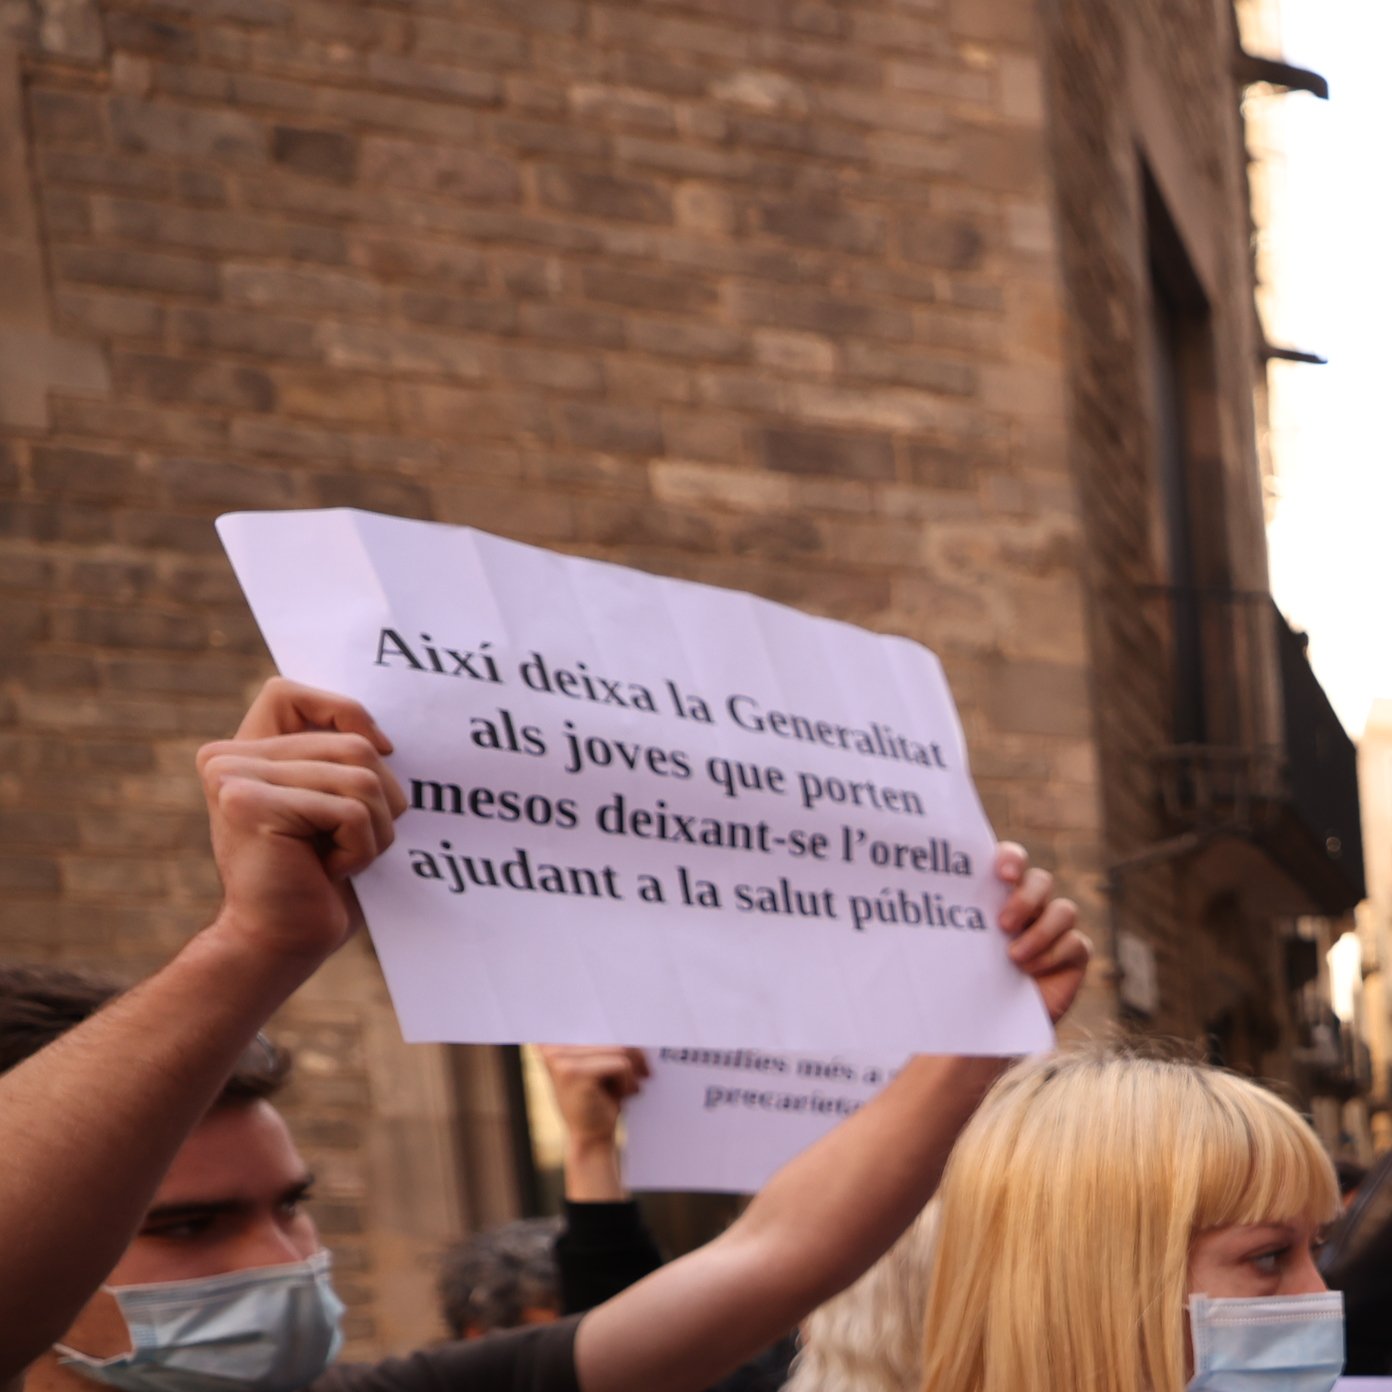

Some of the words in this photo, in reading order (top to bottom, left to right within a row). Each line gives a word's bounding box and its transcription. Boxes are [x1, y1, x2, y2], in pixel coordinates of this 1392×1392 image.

[373, 628, 503, 684] Així
[518, 650, 659, 713] deixa
[666, 679, 714, 724] la
[726, 694, 947, 768] Generalitat
[469, 707, 547, 757] als
[562, 719, 693, 780] joves
[706, 754, 786, 799] que
[797, 770, 925, 816] porten
[409, 776, 579, 830] mesos
[595, 793, 829, 860] deixant-se
[841, 825, 974, 877] l’orella
[409, 840, 623, 901] ajudant
[636, 872, 667, 904] a
[677, 865, 722, 909] la
[734, 877, 839, 920] salut
[848, 886, 989, 932] pública
